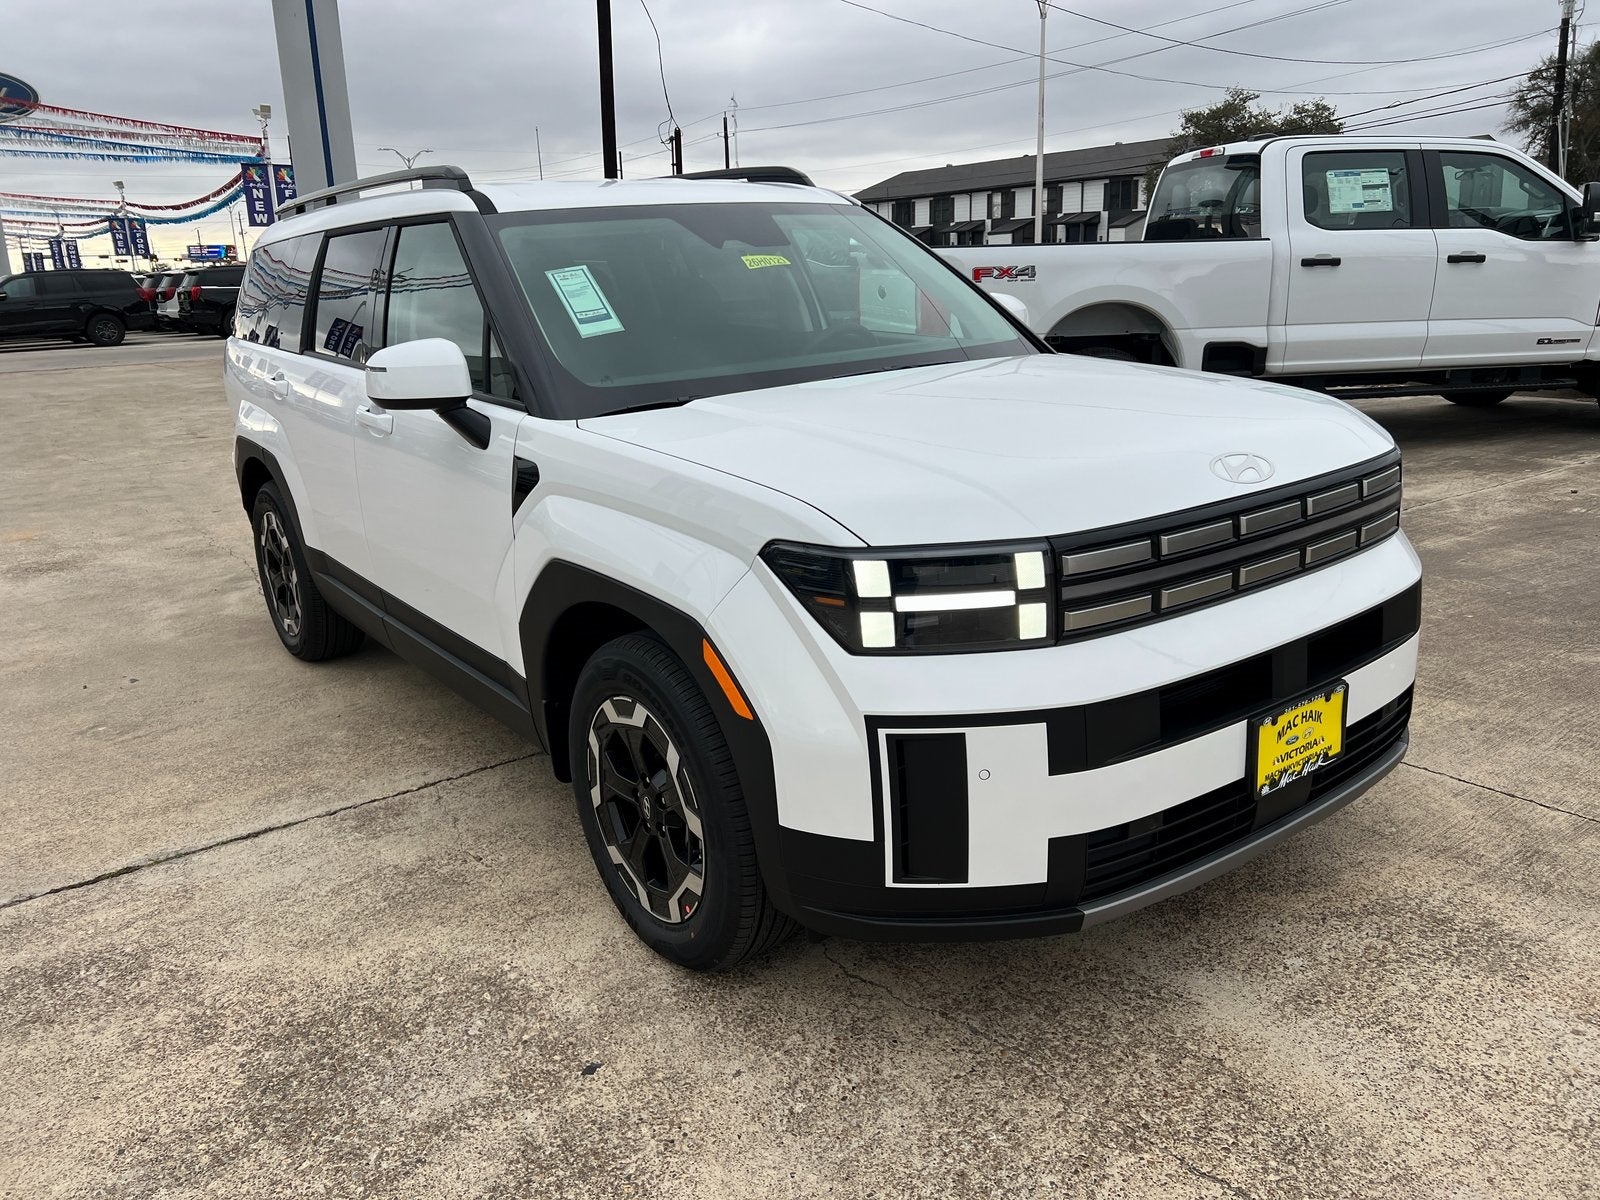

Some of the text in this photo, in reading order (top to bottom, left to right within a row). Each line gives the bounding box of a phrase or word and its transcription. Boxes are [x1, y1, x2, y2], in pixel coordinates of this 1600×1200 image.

[252, 188, 268, 223] NEW
[115, 233, 126, 254] NEW
[136, 232, 145, 254] FORD
[972, 265, 1036, 282] FX4
[1276, 709, 1323, 744] MAC HAIK
[1279, 738, 1318, 763] VICTORIA
[1278, 754, 1336, 788] Mac Haik
